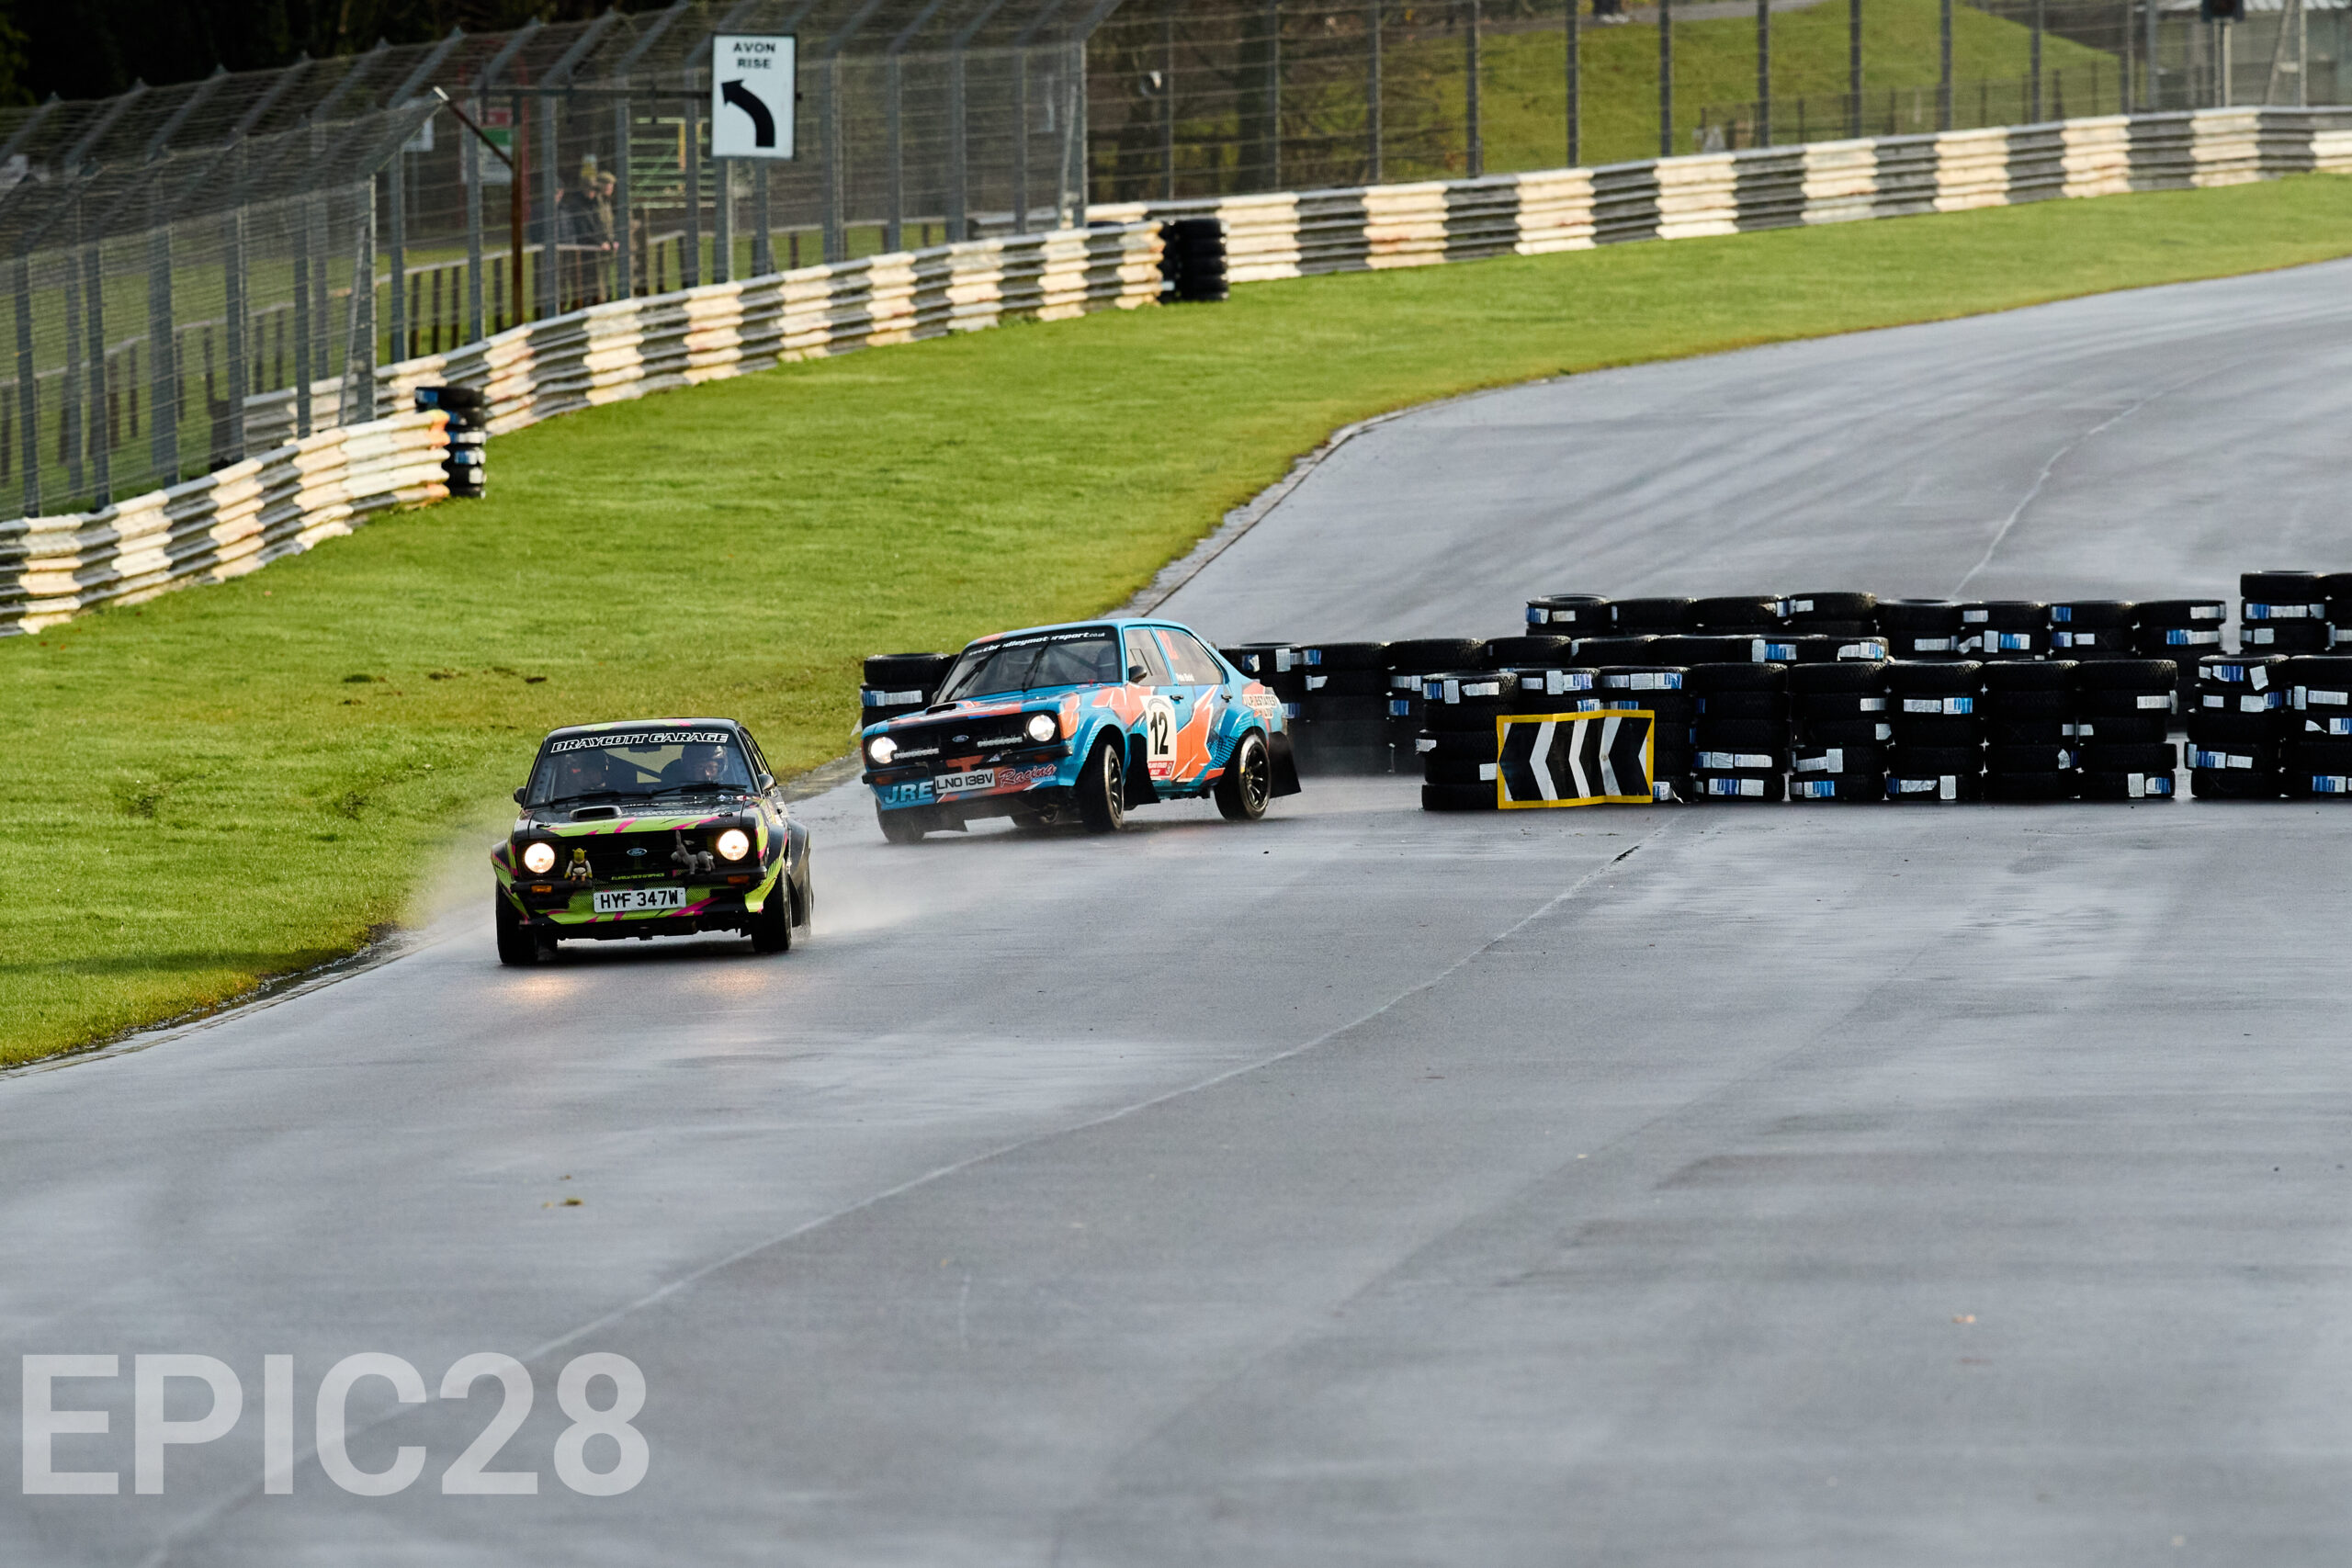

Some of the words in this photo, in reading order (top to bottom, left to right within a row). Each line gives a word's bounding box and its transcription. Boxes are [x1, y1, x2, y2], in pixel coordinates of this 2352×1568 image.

[733, 42, 776, 53] AVON
[737, 58, 772, 69] RISE
[551, 734, 649, 753] DRAYCOTT
[649, 732, 729, 743] GARAGE
[1150, 711, 1169, 755] 12
[936, 776, 963, 790] LNO
[966, 773, 994, 787] 138V
[998, 764, 1057, 788] Racing
[884, 781, 934, 805] JRE
[600, 893, 632, 908] HYF
[637, 889, 679, 907] 347W
